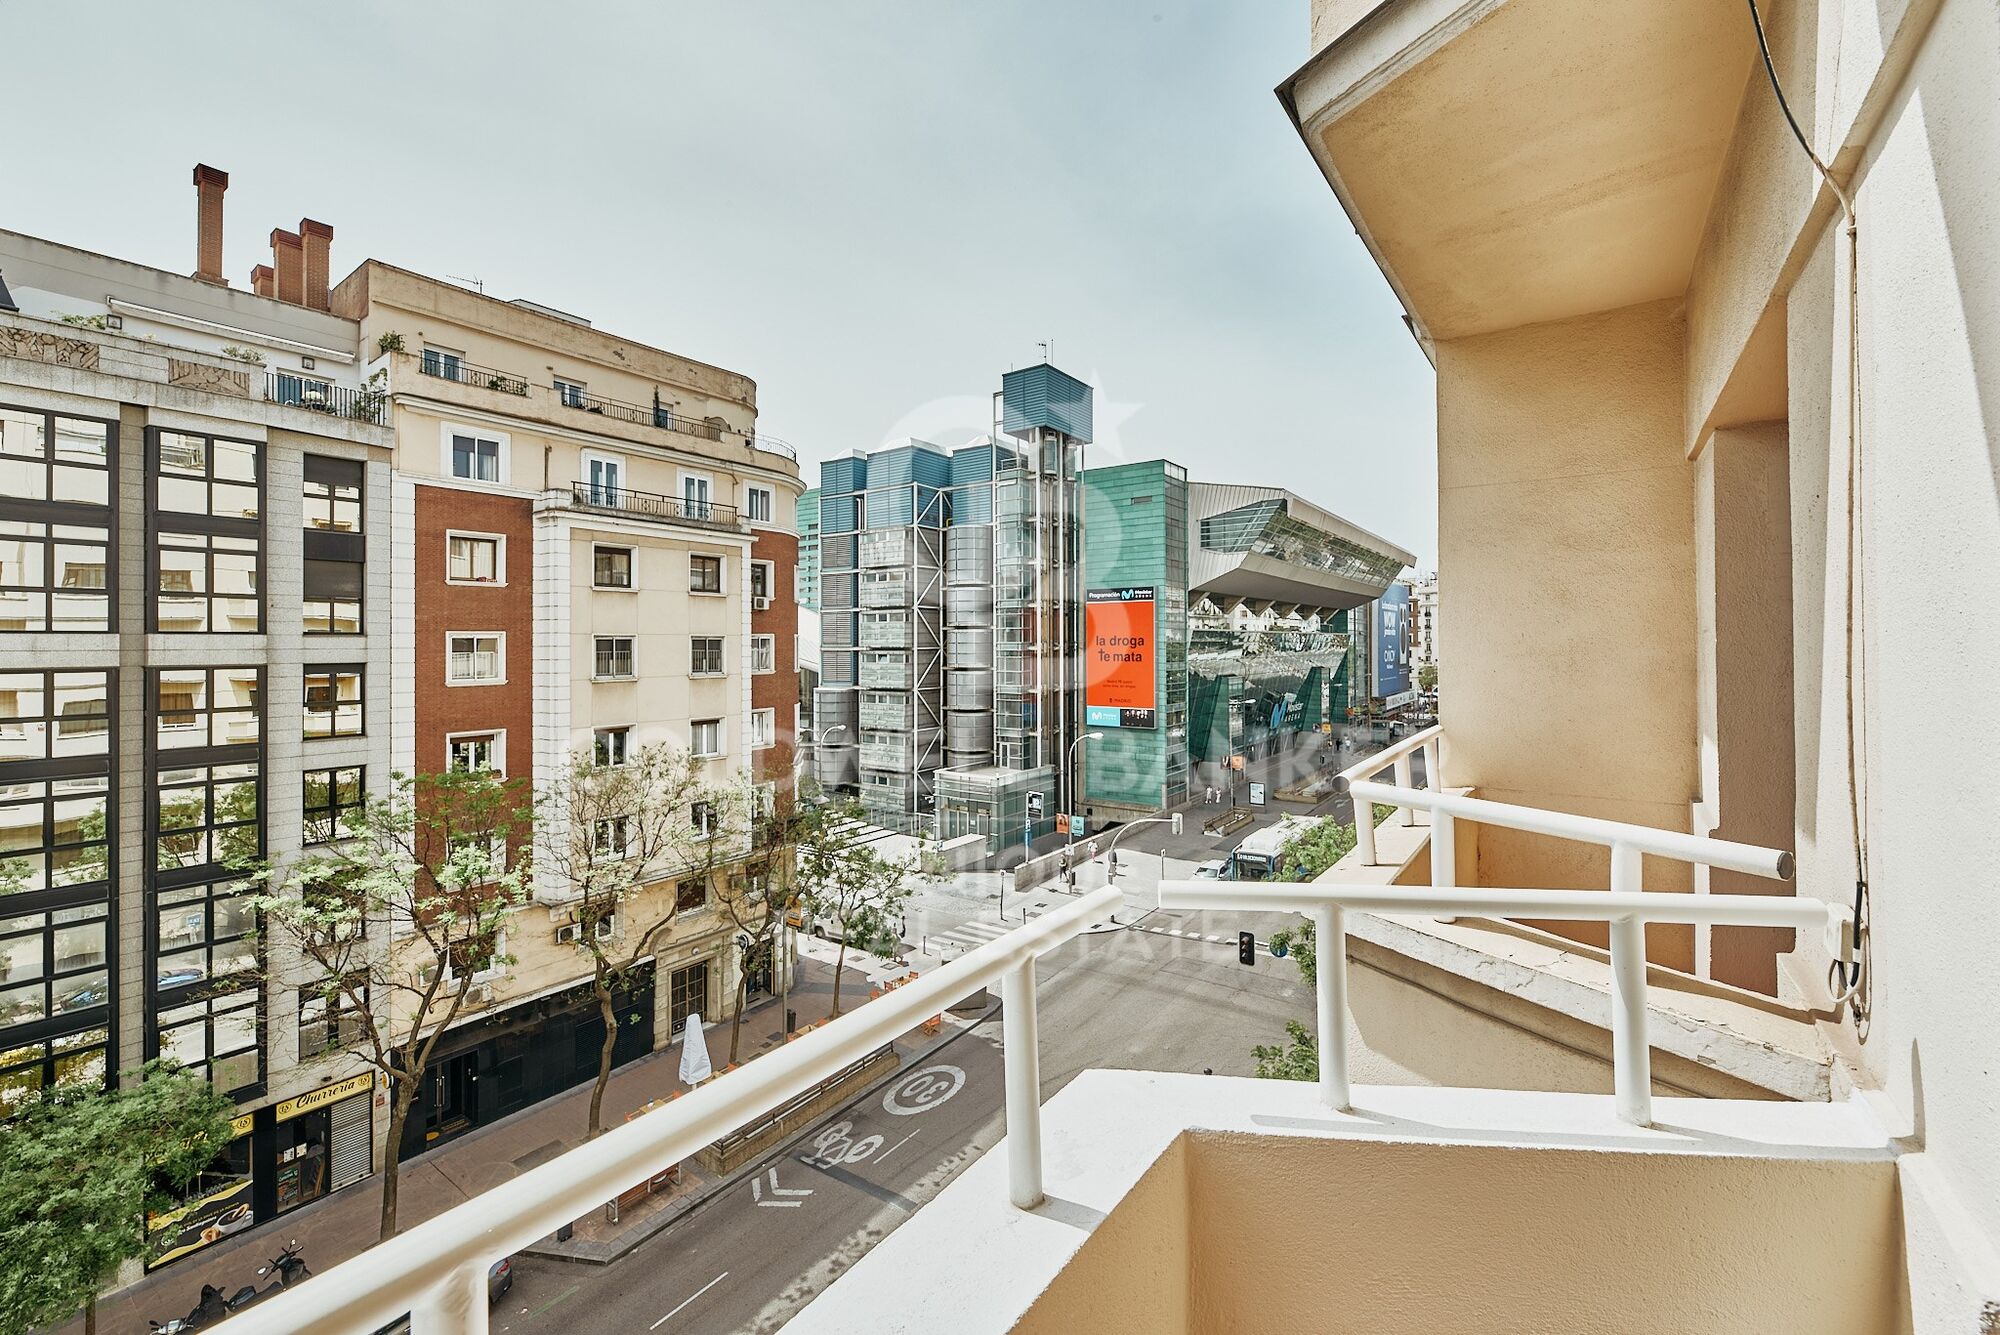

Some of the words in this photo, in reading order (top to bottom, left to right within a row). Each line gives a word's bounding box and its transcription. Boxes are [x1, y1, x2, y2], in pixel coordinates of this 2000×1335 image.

[1096, 635, 1106, 647] la
[1109, 635, 1144, 650] droga
[1113, 650, 1142, 663] mata
[902, 1075, 949, 1104] 30
